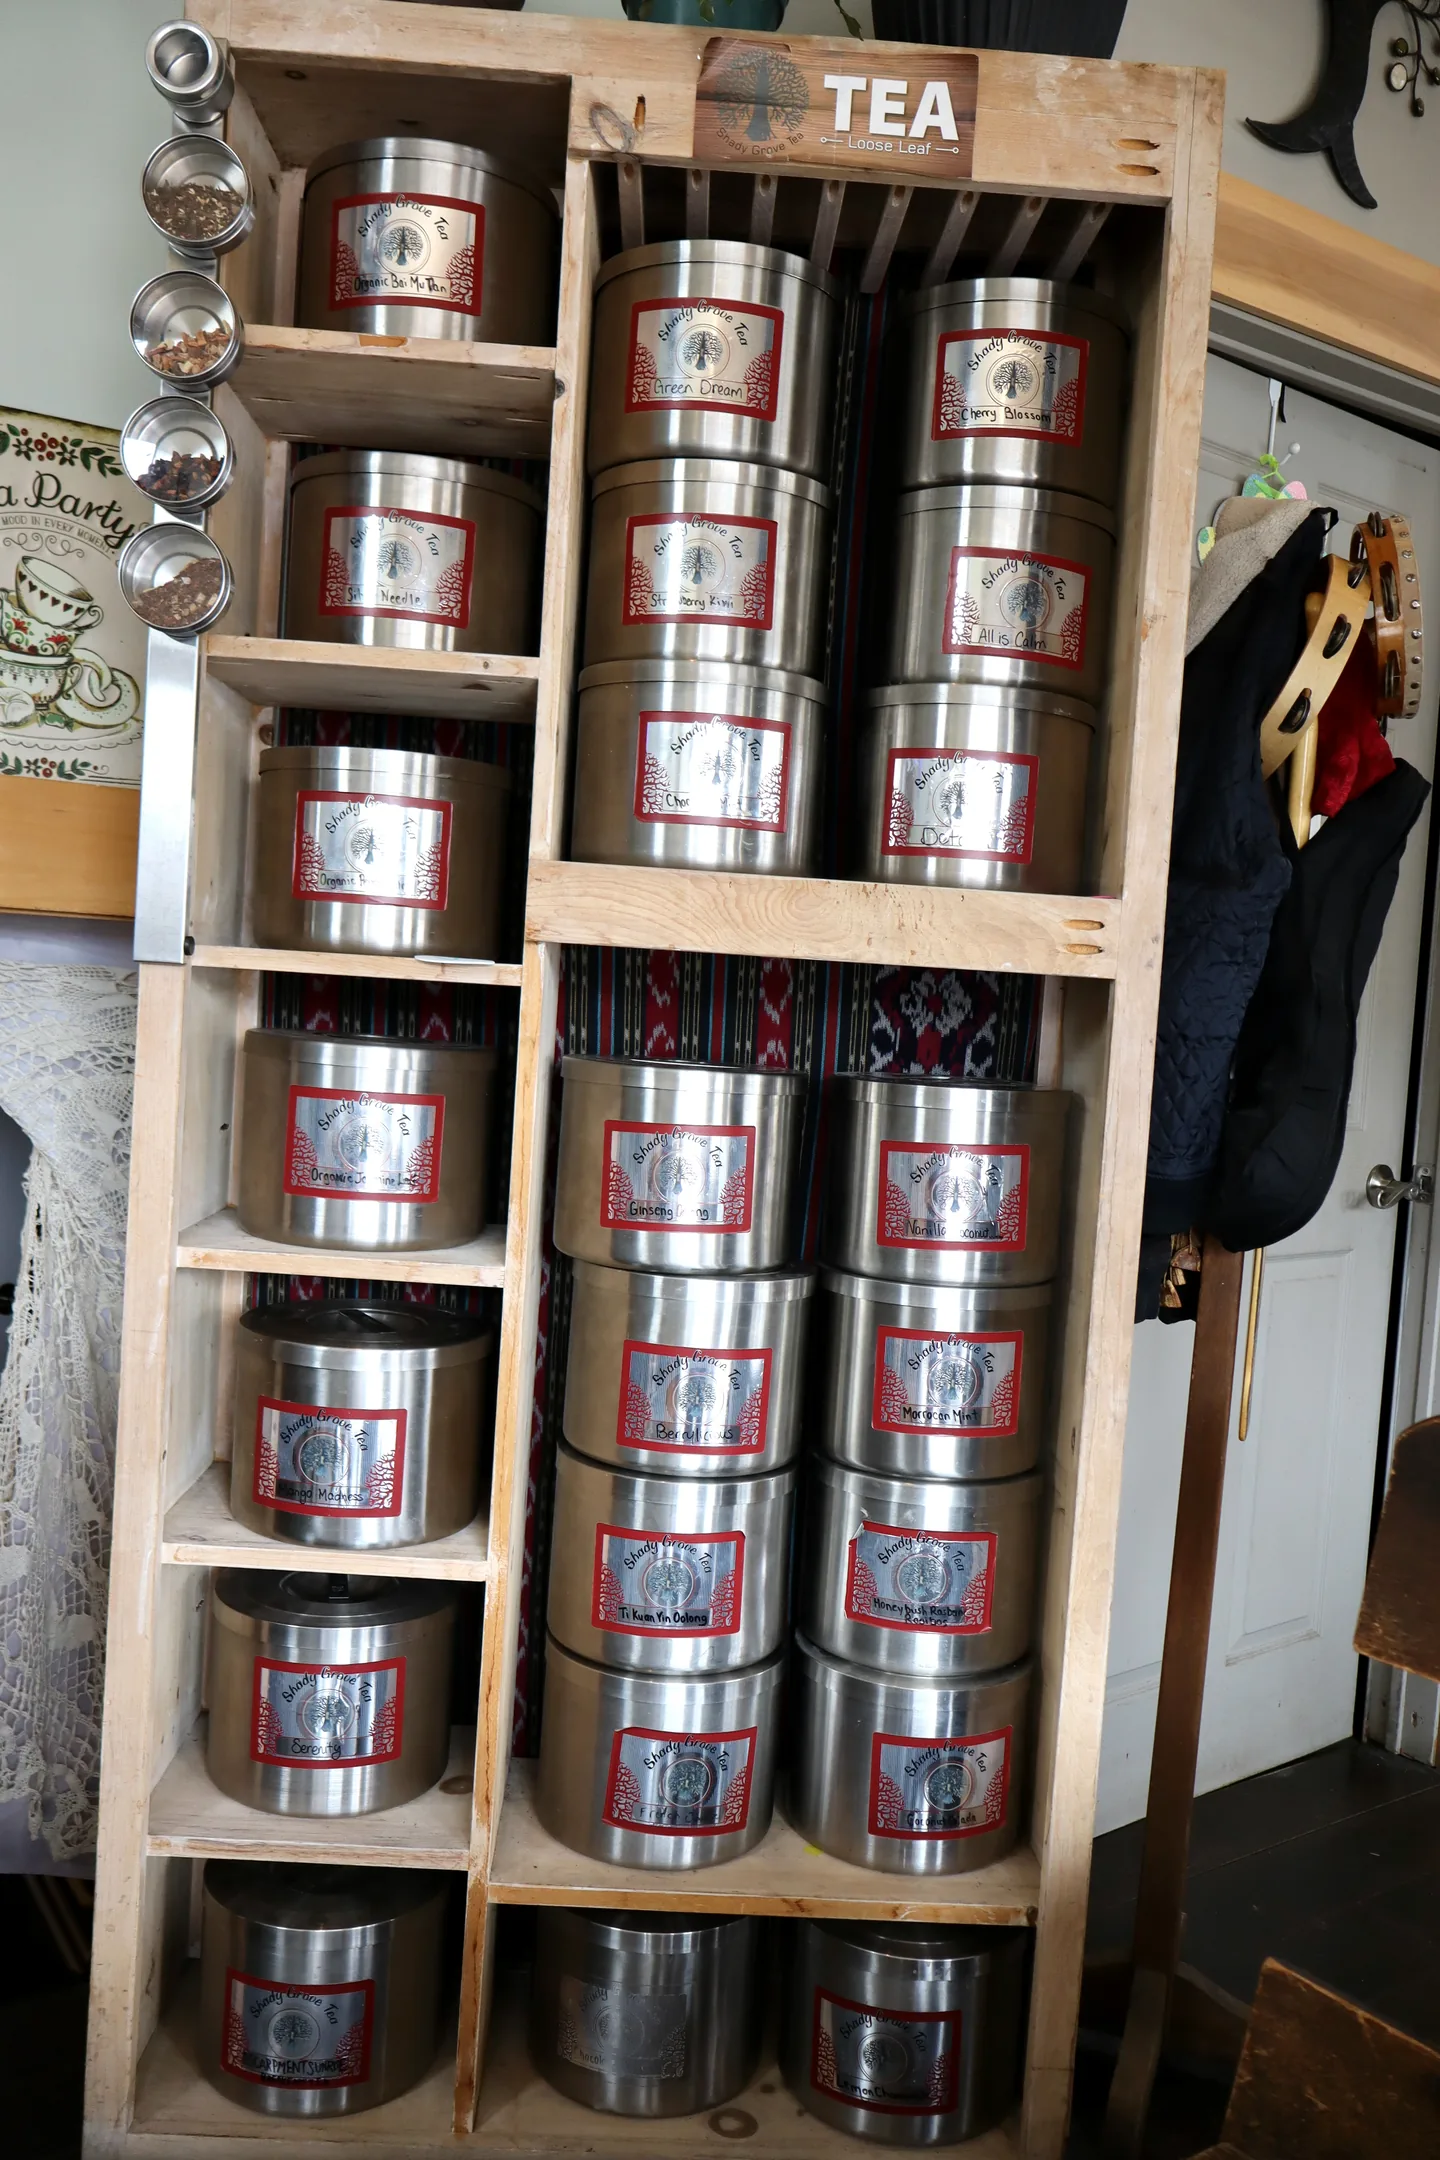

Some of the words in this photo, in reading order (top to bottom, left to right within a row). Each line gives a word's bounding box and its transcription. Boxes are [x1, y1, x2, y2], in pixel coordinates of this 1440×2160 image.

[823, 74, 959, 141] TEA
[716, 128, 748, 155] Shady
[752, 142, 785, 156] Grove
[790, 132, 804, 146] Tea
[848, 136, 892, 152] Loose
[900, 137, 931, 155] Leaf
[358, 201, 392, 237] Shady
[396, 194, 432, 217] Grove
[434, 217, 449, 240] Tea
[354, 276, 389, 292] Organic
[658, 306, 694, 341] Shady
[697, 299, 733, 323] Grove
[734, 323, 749, 346] Tea
[967, 336, 1003, 371] Shady
[1007, 330, 1043, 353] Grove
[1043, 352, 1057, 374] Tea
[654, 379, 693, 394] Green
[700, 379, 742, 398] Dream
[961, 409, 997, 421] Cherry
[1004, 407, 1051, 423] Blossom
[24, 471, 135, 549] Party
[32, 516, 40, 525] IN
[45, 518, 74, 532] EVERY
[389, 510, 424, 533] Grove
[426, 533, 439, 556] Tea
[692, 515, 728, 537] Grove
[729, 536, 743, 559] Tea
[982, 557, 1018, 589] Shady
[1022, 553, 1054, 577] Grove
[1054, 578, 1067, 600] Tea
[381, 590, 423, 606] Needle
[978, 629, 993, 643] All
[998, 632, 1009, 645] is
[1015, 631, 1047, 649] Calm
[915, 756, 950, 790] Shady
[325, 801, 360, 834] Shady
[320, 873, 355, 889] Organic
[318, 1098, 354, 1131] Shady
[397, 1114, 411, 1136] Tea
[633, 1131, 668, 1164] Shady
[709, 1146, 723, 1168] Tea
[910, 1151, 945, 1183] Shady
[630, 1202, 673, 1220] Ginseng
[953, 1228, 989, 1238] oconut
[908, 1339, 943, 1370] Shady
[947, 1334, 981, 1354] Grove
[982, 1352, 995, 1373] Tea
[652, 1356, 688, 1386] Shady
[728, 1369, 741, 1390] Tea
[280, 1415, 313, 1444] Shady
[317, 1409, 352, 1431] Grove
[355, 1430, 369, 1451] Tea
[903, 1407, 950, 1420] Morrocan
[953, 1409, 979, 1424] Mint
[319, 1488, 364, 1501] Madness
[624, 1539, 658, 1570] Shady
[662, 1534, 697, 1555] Grove
[699, 1553, 713, 1573] Tea
[878, 1535, 912, 1564] Shady
[916, 1532, 950, 1552] Grove
[952, 1551, 966, 1571] Tea
[619, 1607, 629, 1619] Ti
[632, 1609, 655, 1622] Kuan
[657, 1612, 670, 1623] Yin
[673, 1612, 707, 1626] Oolong
[282, 1672, 317, 1703] Shady
[321, 1666, 356, 1685] Grove
[358, 1682, 373, 1702] Tea
[292, 1738, 342, 1760] Serenity
[644, 1740, 681, 1770] Shady
[684, 1735, 717, 1754] Grove
[717, 1751, 729, 1771] Tea
[905, 1746, 940, 1777] Shady
[943, 1741, 975, 1756] Grove
[976, 1753, 988, 1772] Tea
[250, 1990, 284, 2018] Shady
[287, 1986, 322, 2006] Grove
[324, 2003, 339, 2024] Tea
[840, 2011, 873, 2039] Shady
[913, 2032, 927, 2052] Tea
